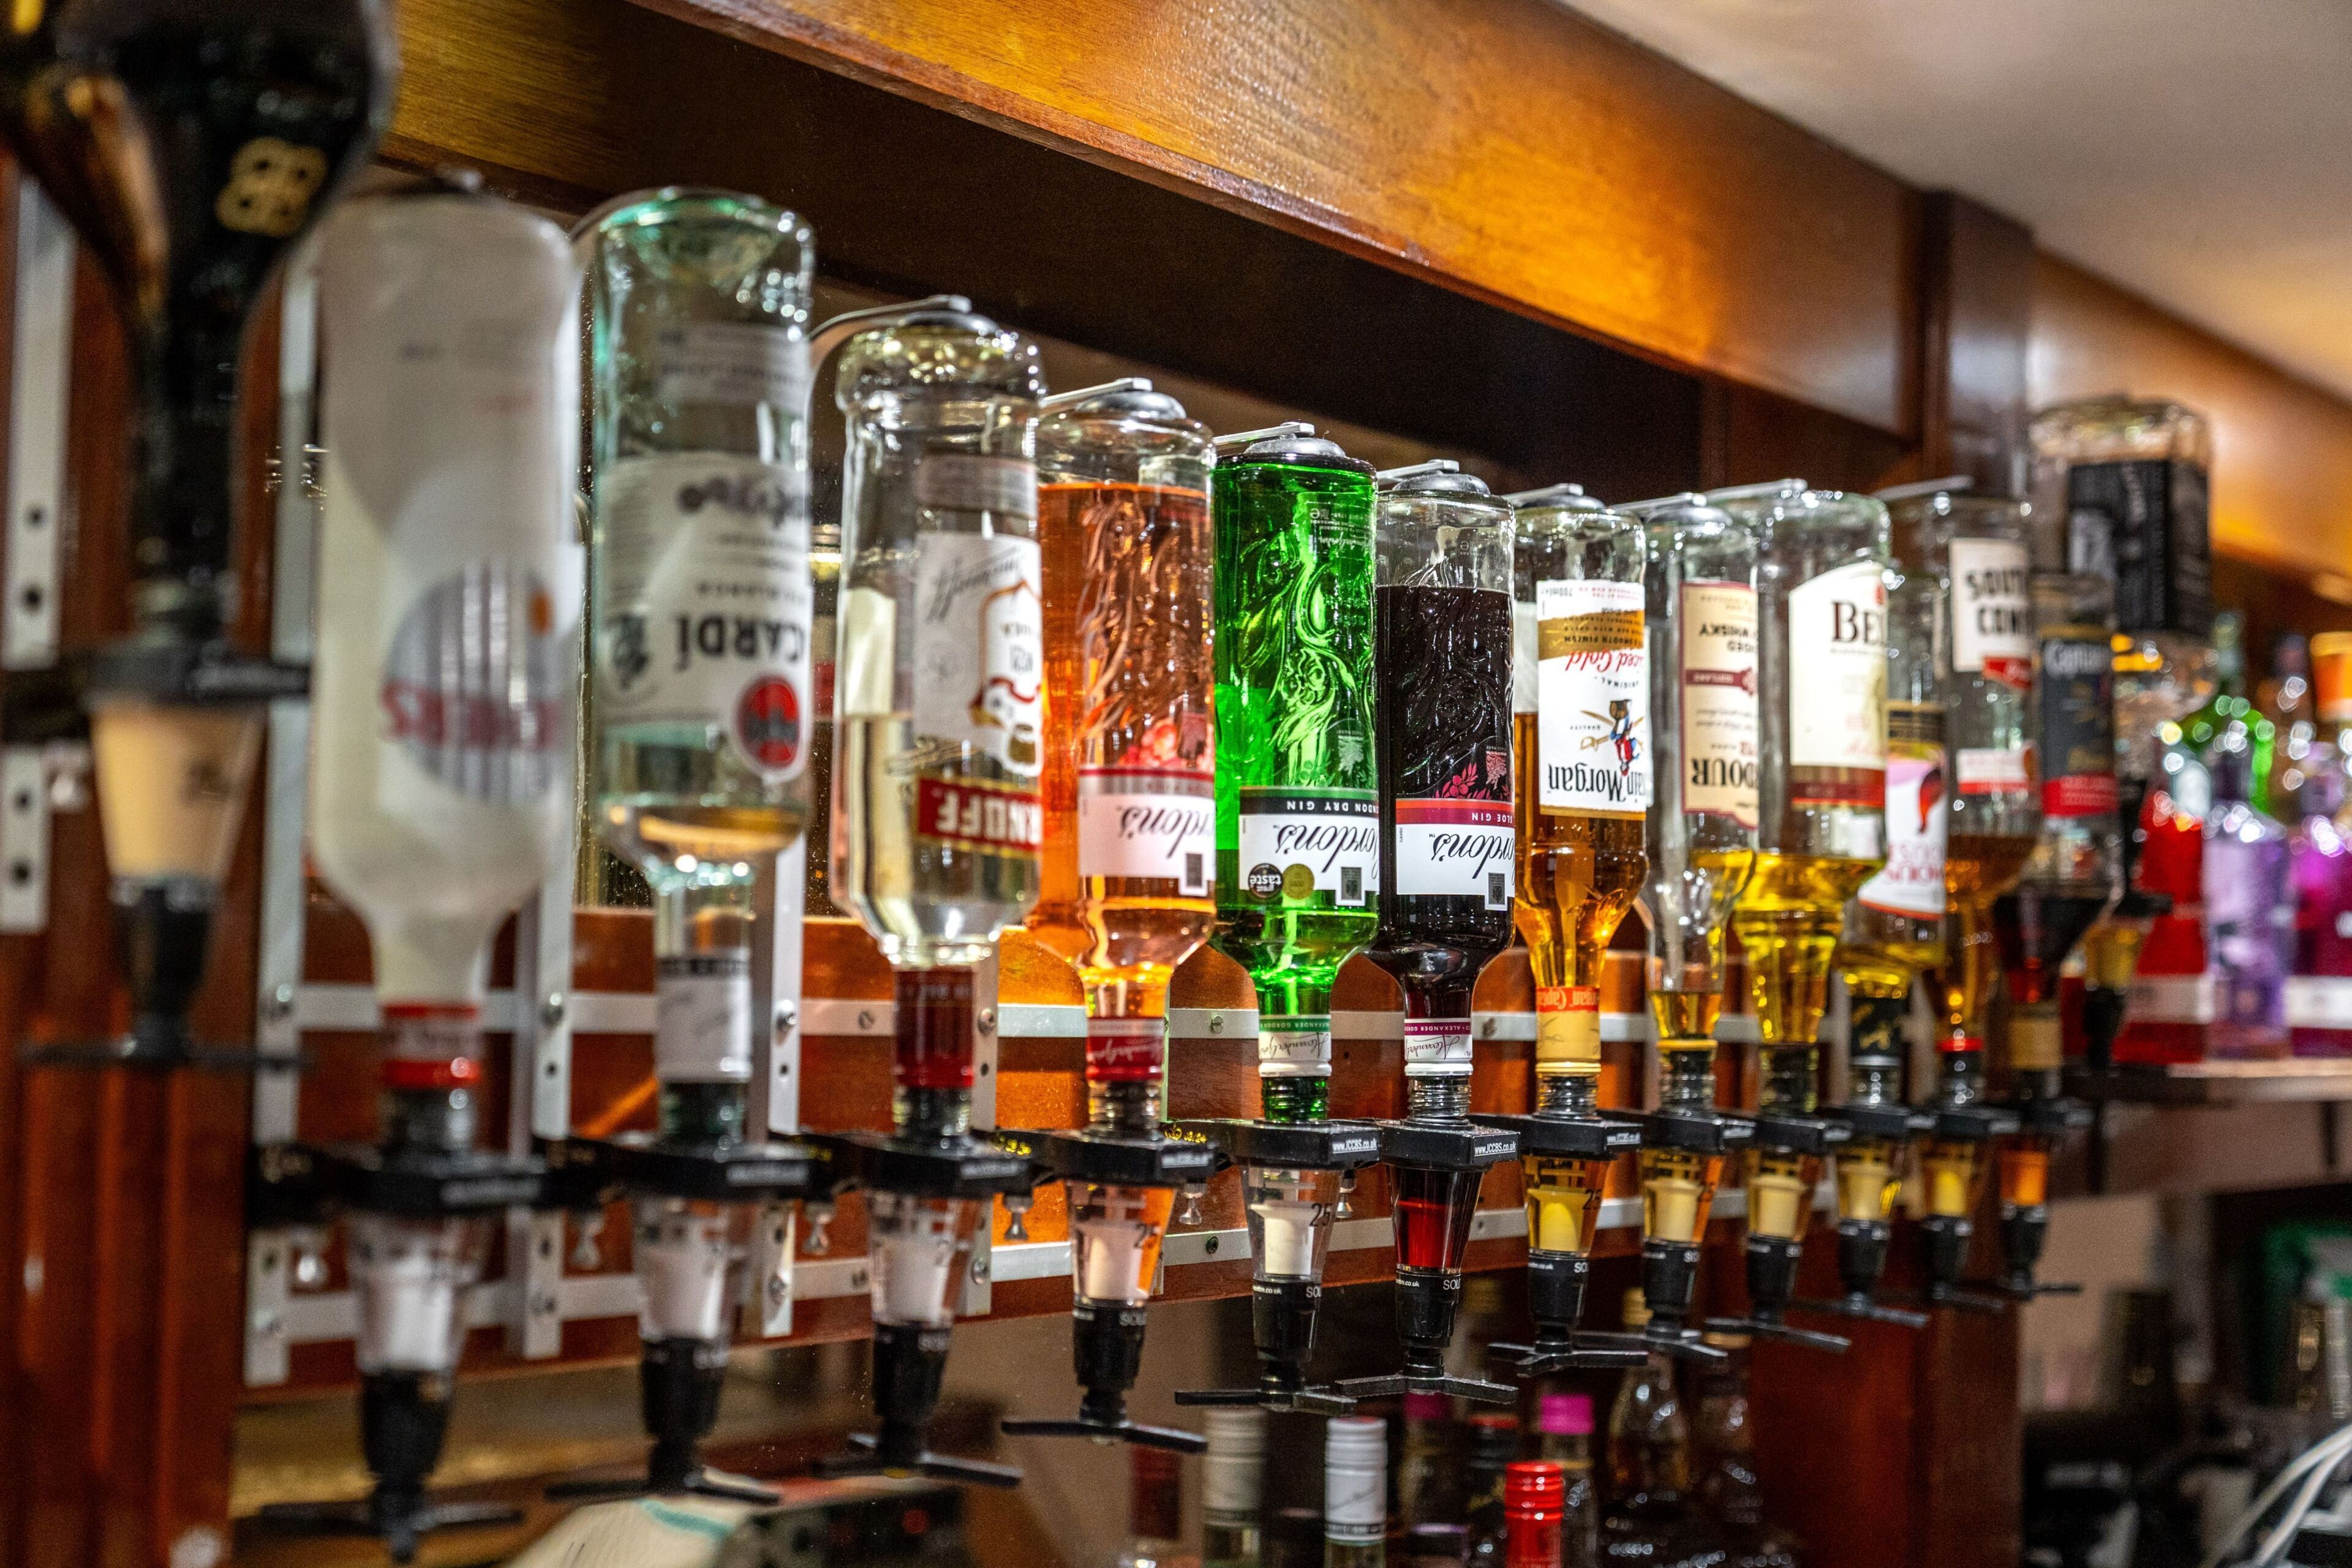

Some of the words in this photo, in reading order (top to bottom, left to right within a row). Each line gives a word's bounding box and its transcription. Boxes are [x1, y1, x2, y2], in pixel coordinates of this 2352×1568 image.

[1831, 600, 1887, 647] BE
[1566, 651, 1613, 673] Gold
[1548, 763, 1626, 802] Morgan
[1286, 800, 1315, 810] GIN
[1325, 802, 1349, 812] DRY
[1471, 812, 1491, 822] GIN
[1496, 813, 1513, 824] SLOE
[1249, 875, 1282, 886] taste
[1474, 1140, 1517, 1156] www.JCCBS.co.uk
[1309, 1202, 1333, 1227] 25
